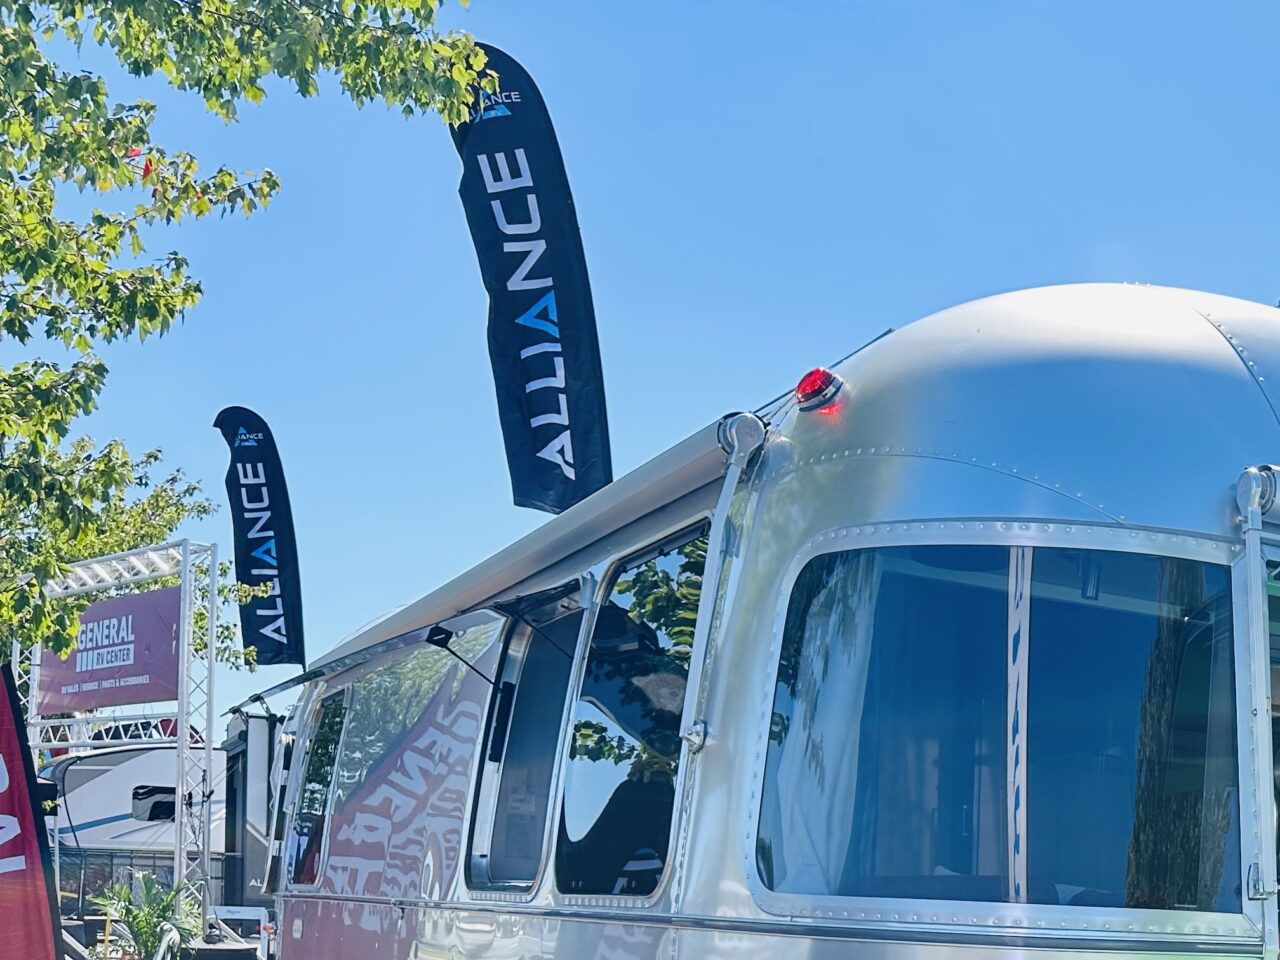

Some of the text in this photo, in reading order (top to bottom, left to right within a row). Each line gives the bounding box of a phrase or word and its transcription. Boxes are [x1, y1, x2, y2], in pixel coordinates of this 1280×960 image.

[477, 148, 576, 481] ALLIANCE
[77, 614, 135, 651] GENERAL
[95, 647, 131, 667] RV CENTER
